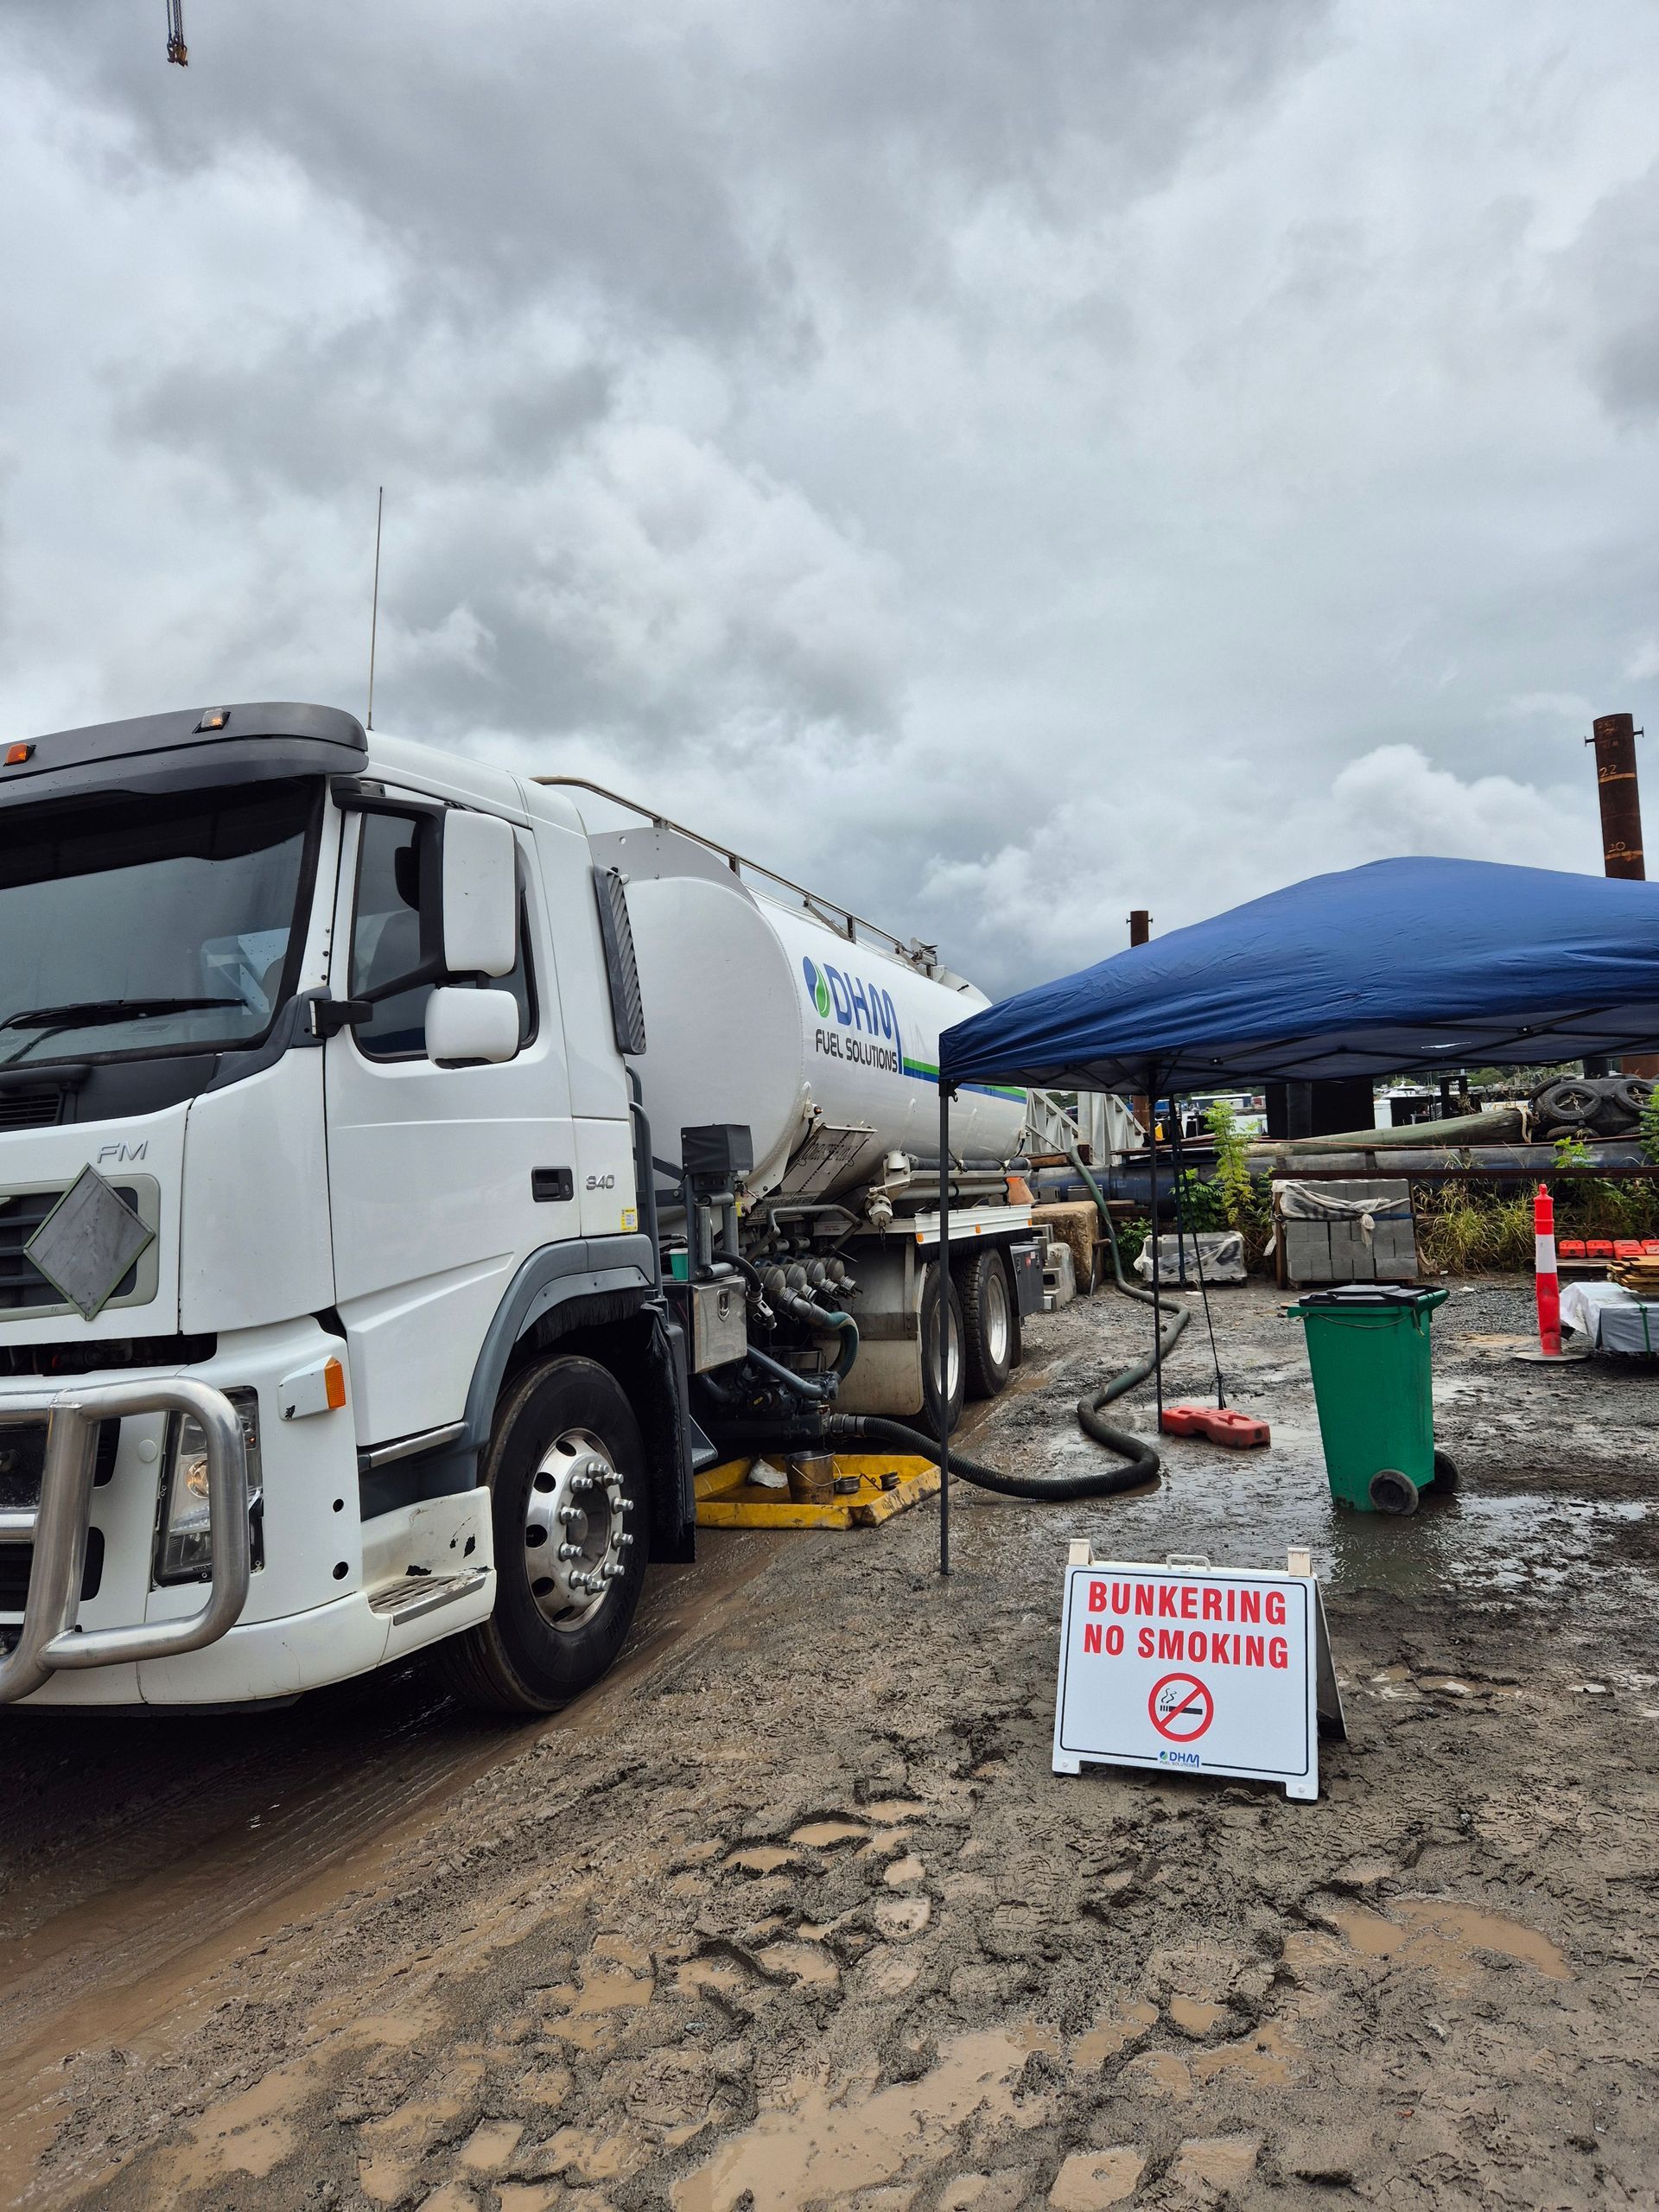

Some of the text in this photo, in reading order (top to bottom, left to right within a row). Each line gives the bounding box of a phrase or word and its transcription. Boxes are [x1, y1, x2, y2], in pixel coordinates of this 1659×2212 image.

[1599, 764, 1617, 777] 22
[823, 963, 903, 1075] DHM
[815, 1028, 898, 1073] FUEL SOLUTIONS
[97, 1140, 149, 1164] FM
[586, 1174, 615, 1191] 340
[1088, 1580, 1287, 1625] BUNKERING
[1084, 1623, 1288, 1669] NO SMOKING
[1169, 1751, 1200, 1769] DHM
